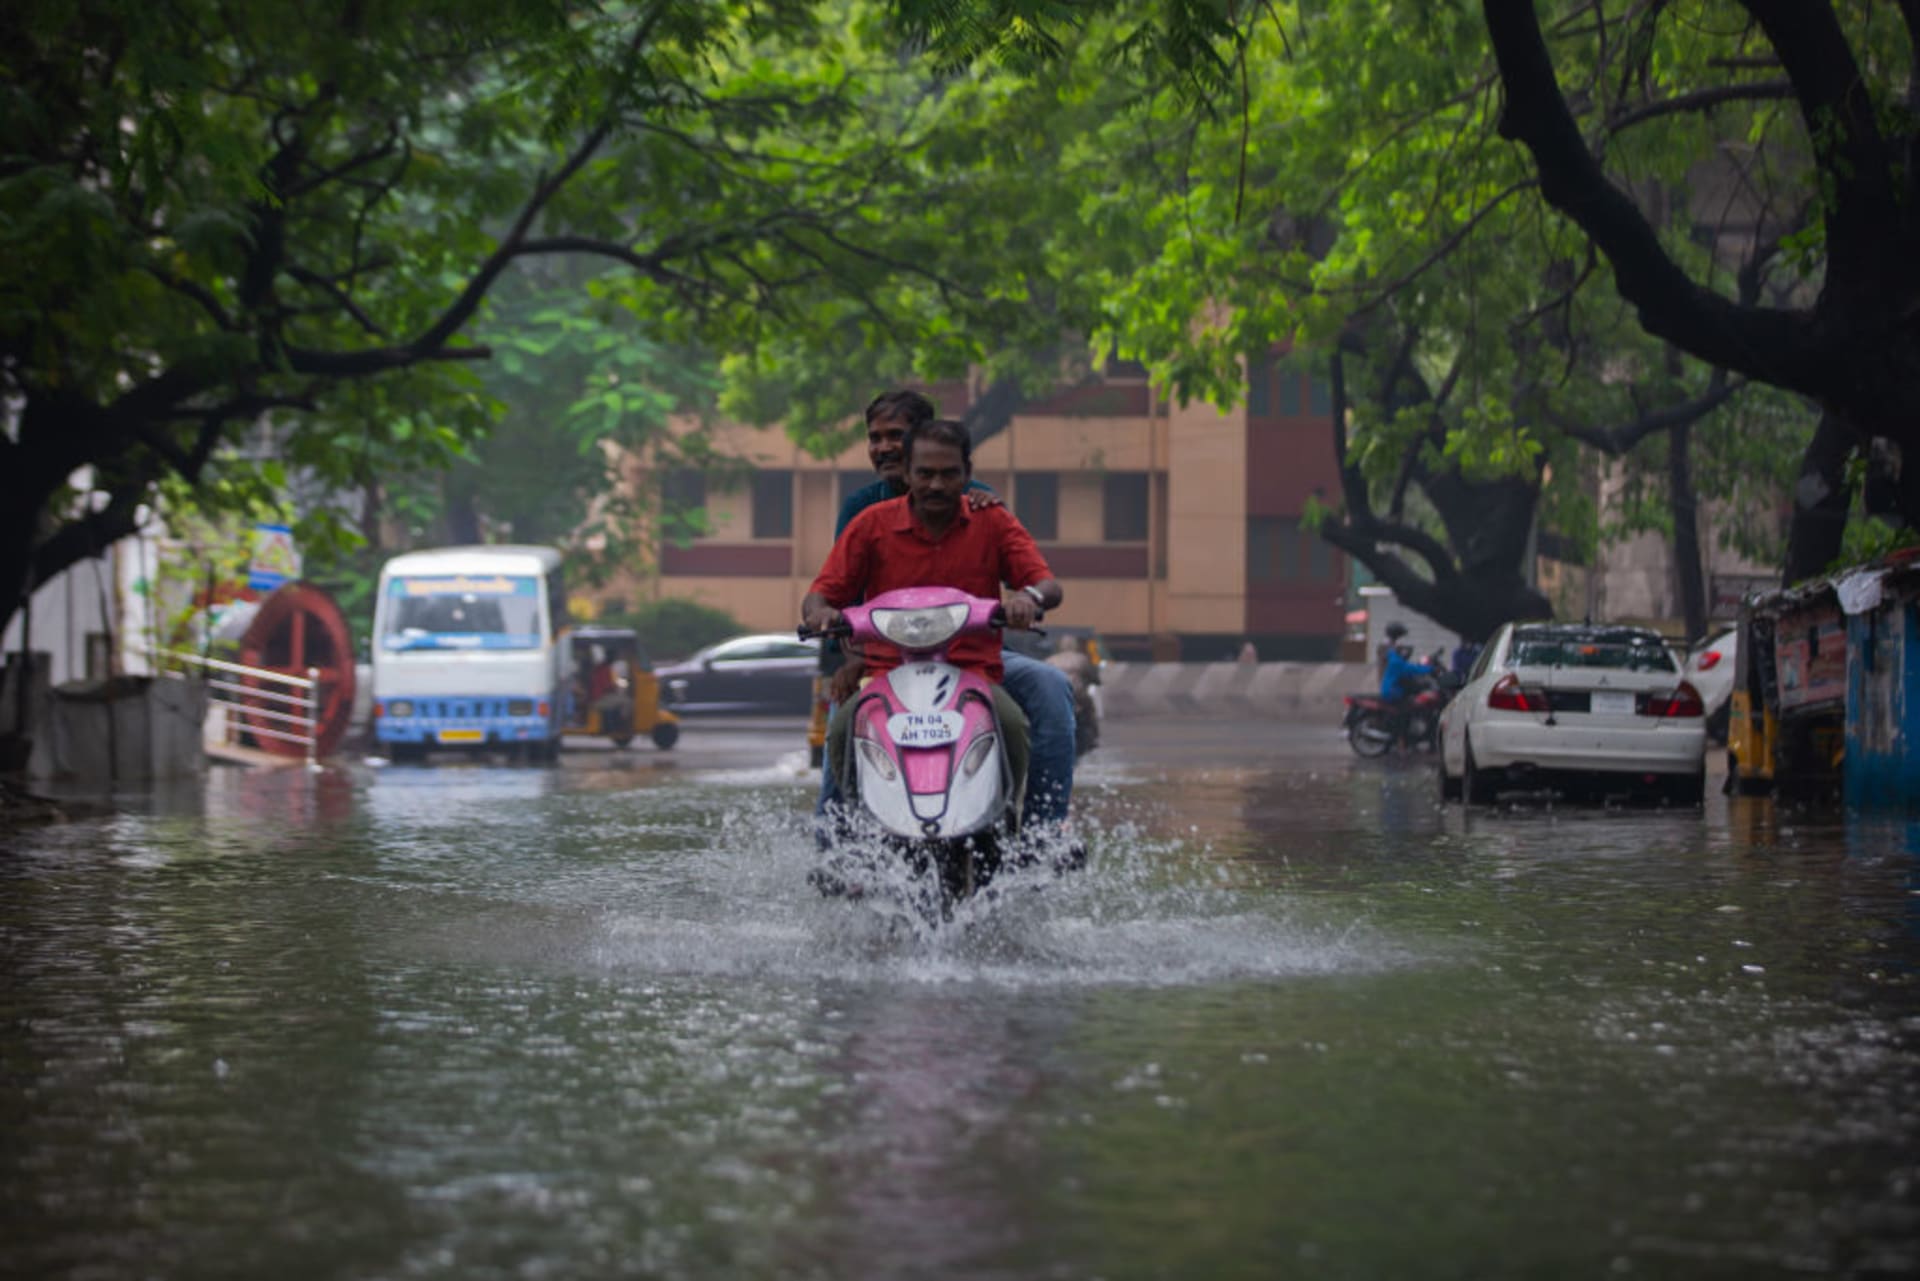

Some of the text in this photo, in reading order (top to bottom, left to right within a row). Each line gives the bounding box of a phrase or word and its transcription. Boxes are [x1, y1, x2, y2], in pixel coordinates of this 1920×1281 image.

[907, 714, 942, 726] TN 04
[901, 730, 918, 740] AH
